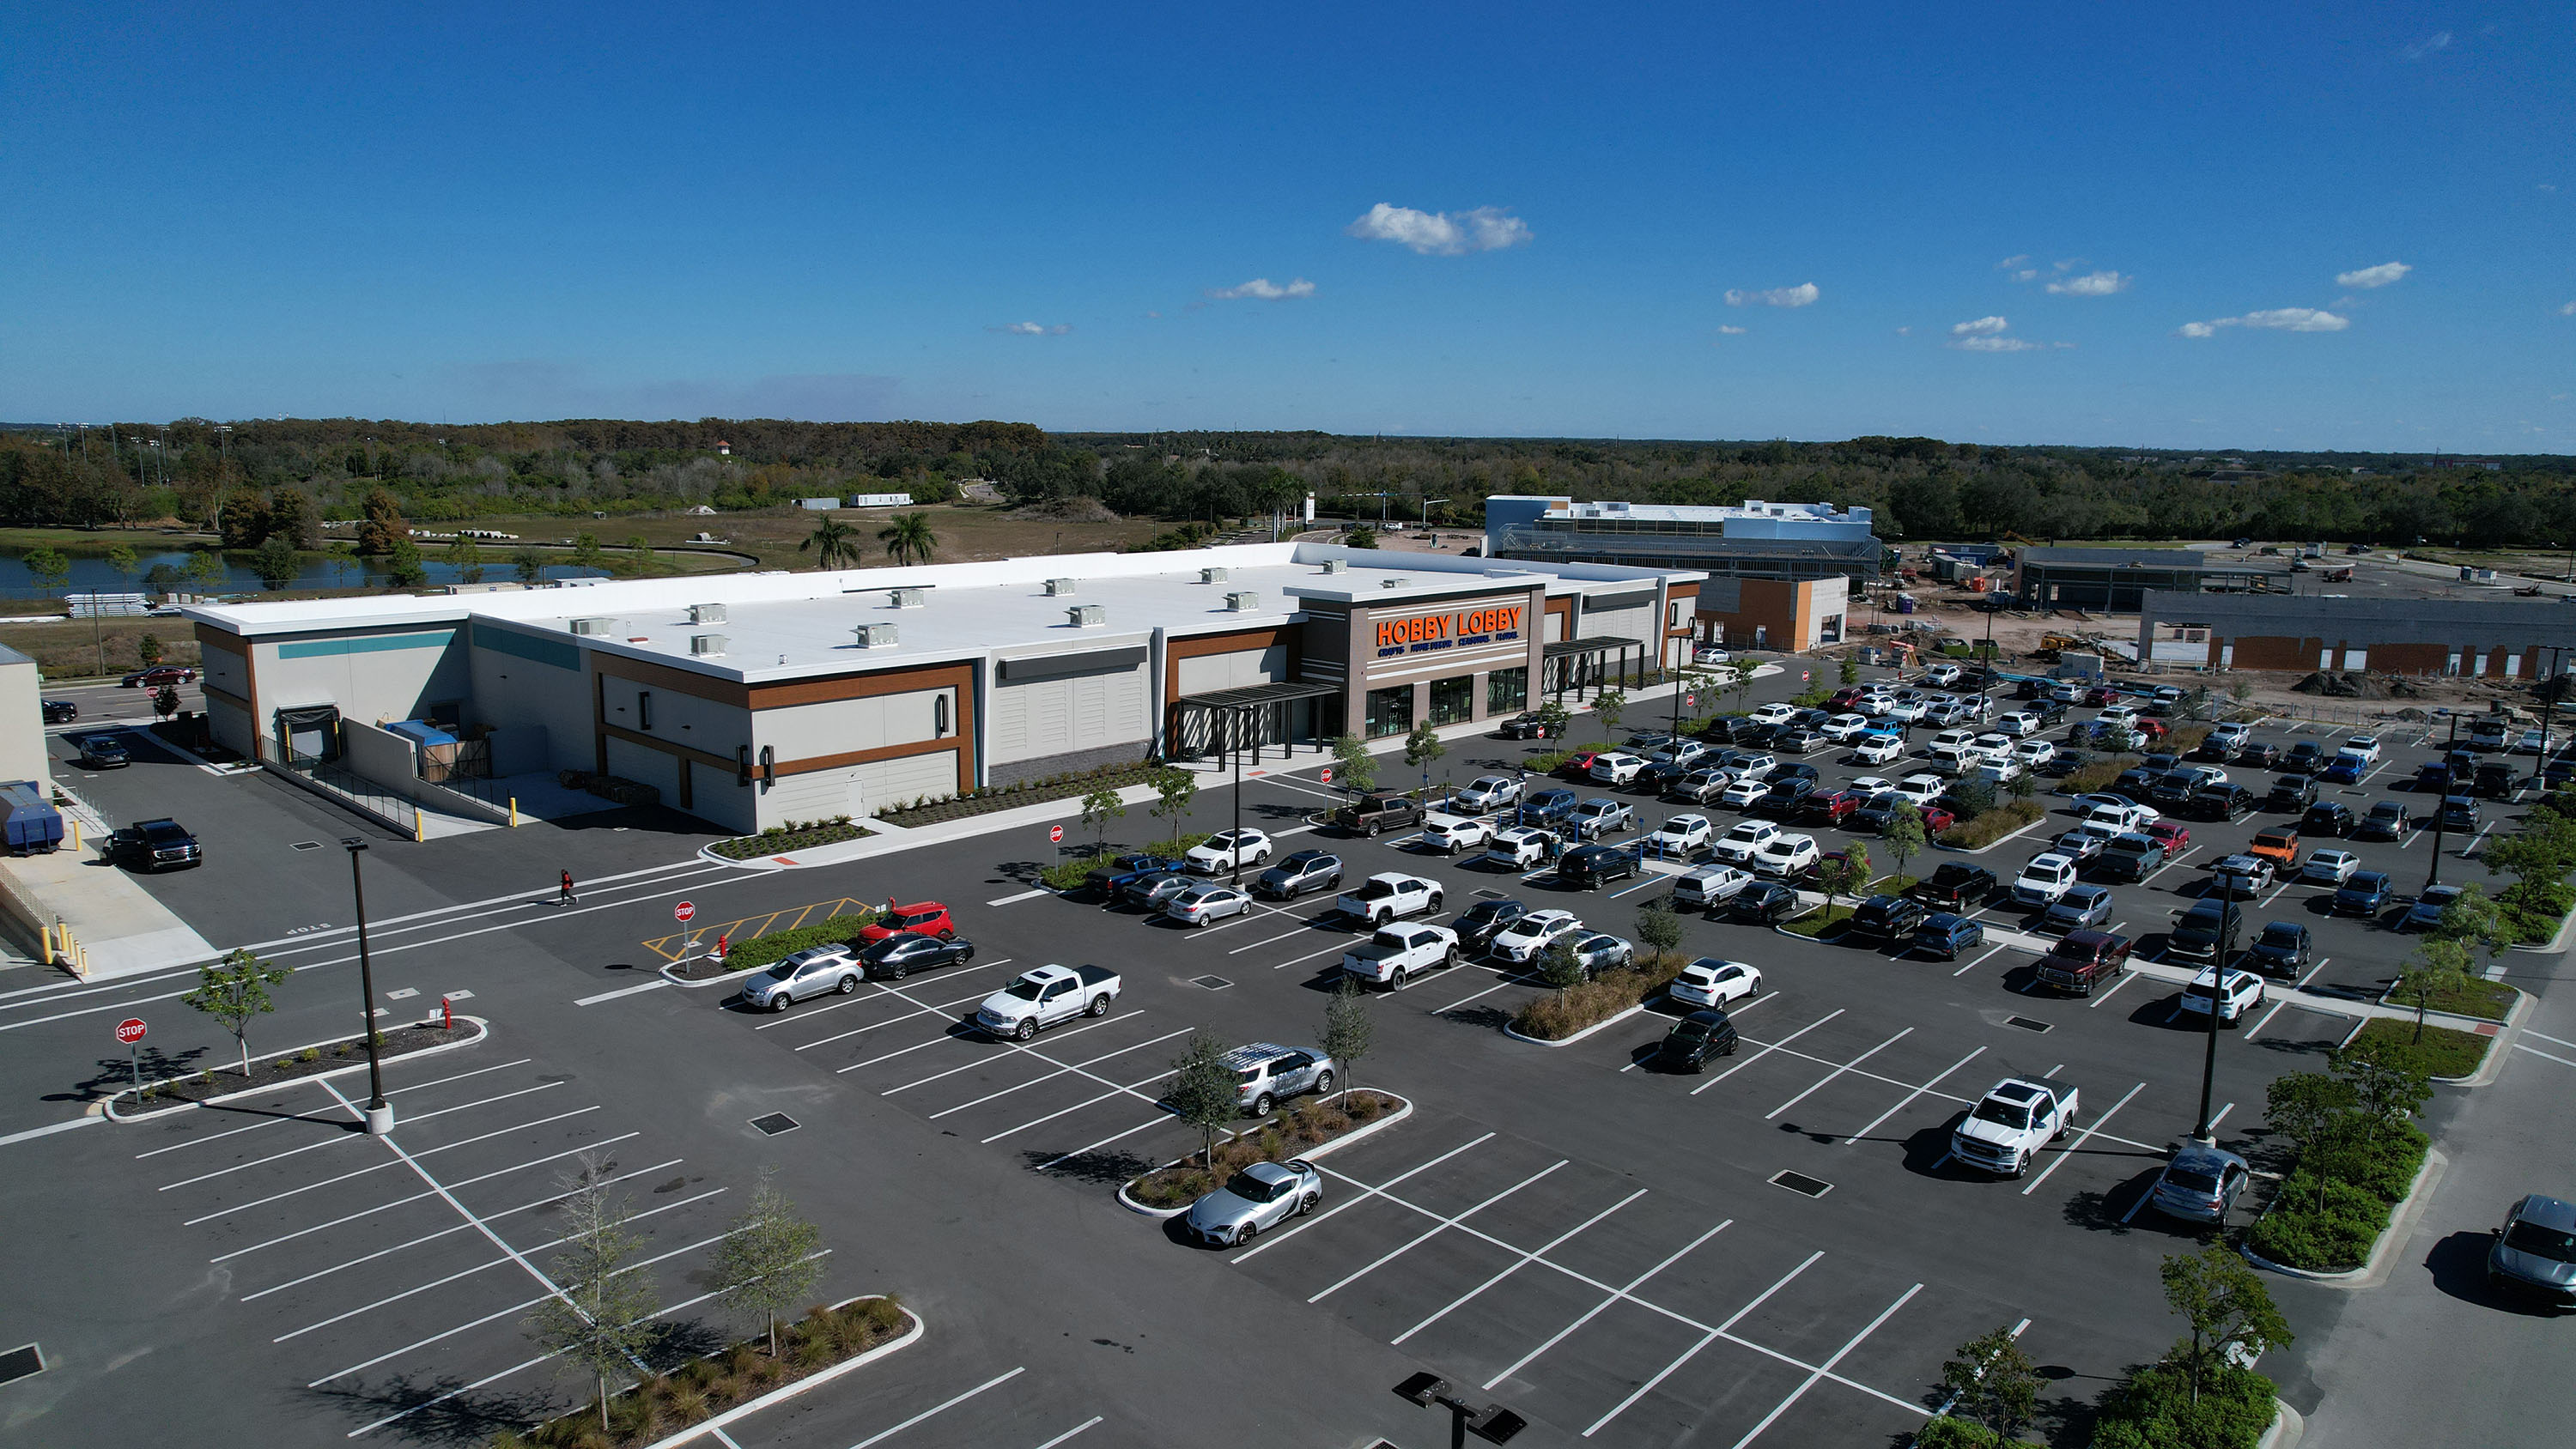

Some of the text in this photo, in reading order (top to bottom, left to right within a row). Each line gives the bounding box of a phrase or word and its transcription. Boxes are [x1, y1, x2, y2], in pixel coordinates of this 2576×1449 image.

[1376, 606, 1522, 646] HOBBY LOBBY
[677, 906, 694, 917] STOP
[287, 923, 331, 935] STOP
[118, 1024, 144, 1038] STOP
